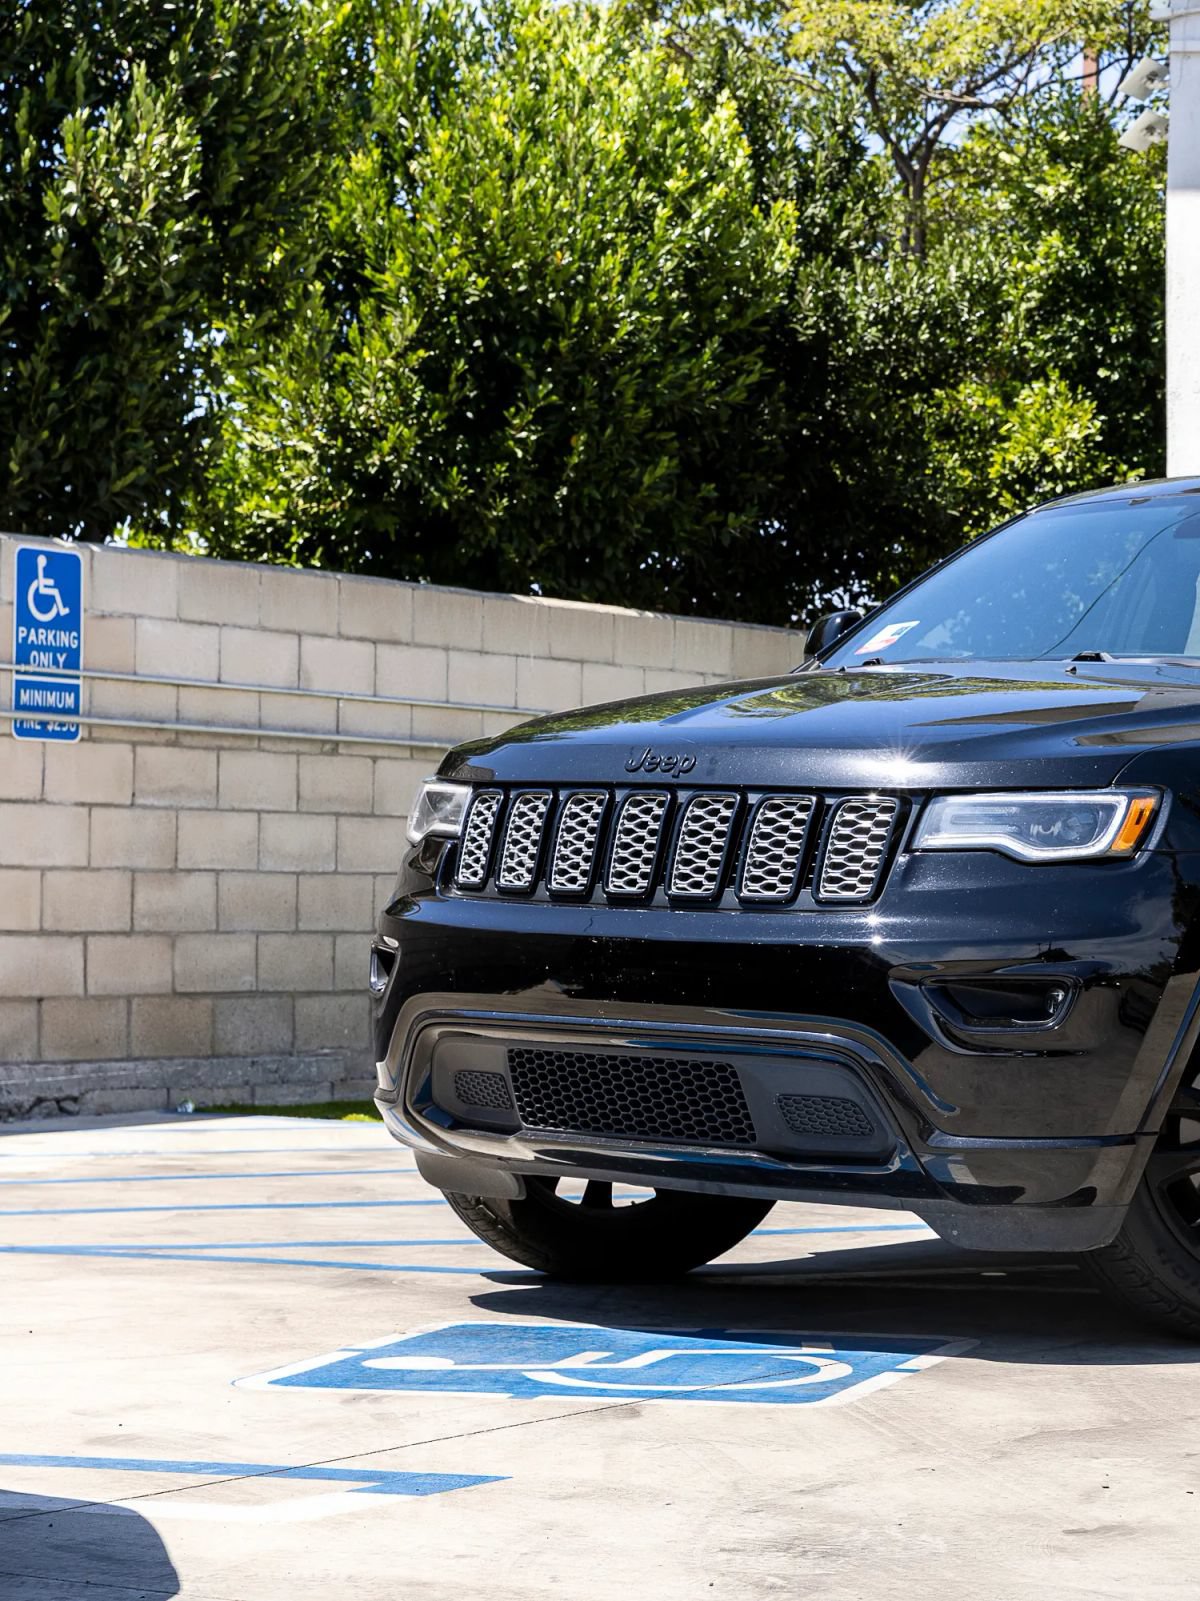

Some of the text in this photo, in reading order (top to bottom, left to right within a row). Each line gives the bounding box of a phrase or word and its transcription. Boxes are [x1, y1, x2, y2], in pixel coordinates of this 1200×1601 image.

[18, 626, 79, 649] PARKING
[30, 650, 68, 669] ONLY
[20, 688, 75, 709] MINIMUM
[624, 747, 697, 778] Jeep
